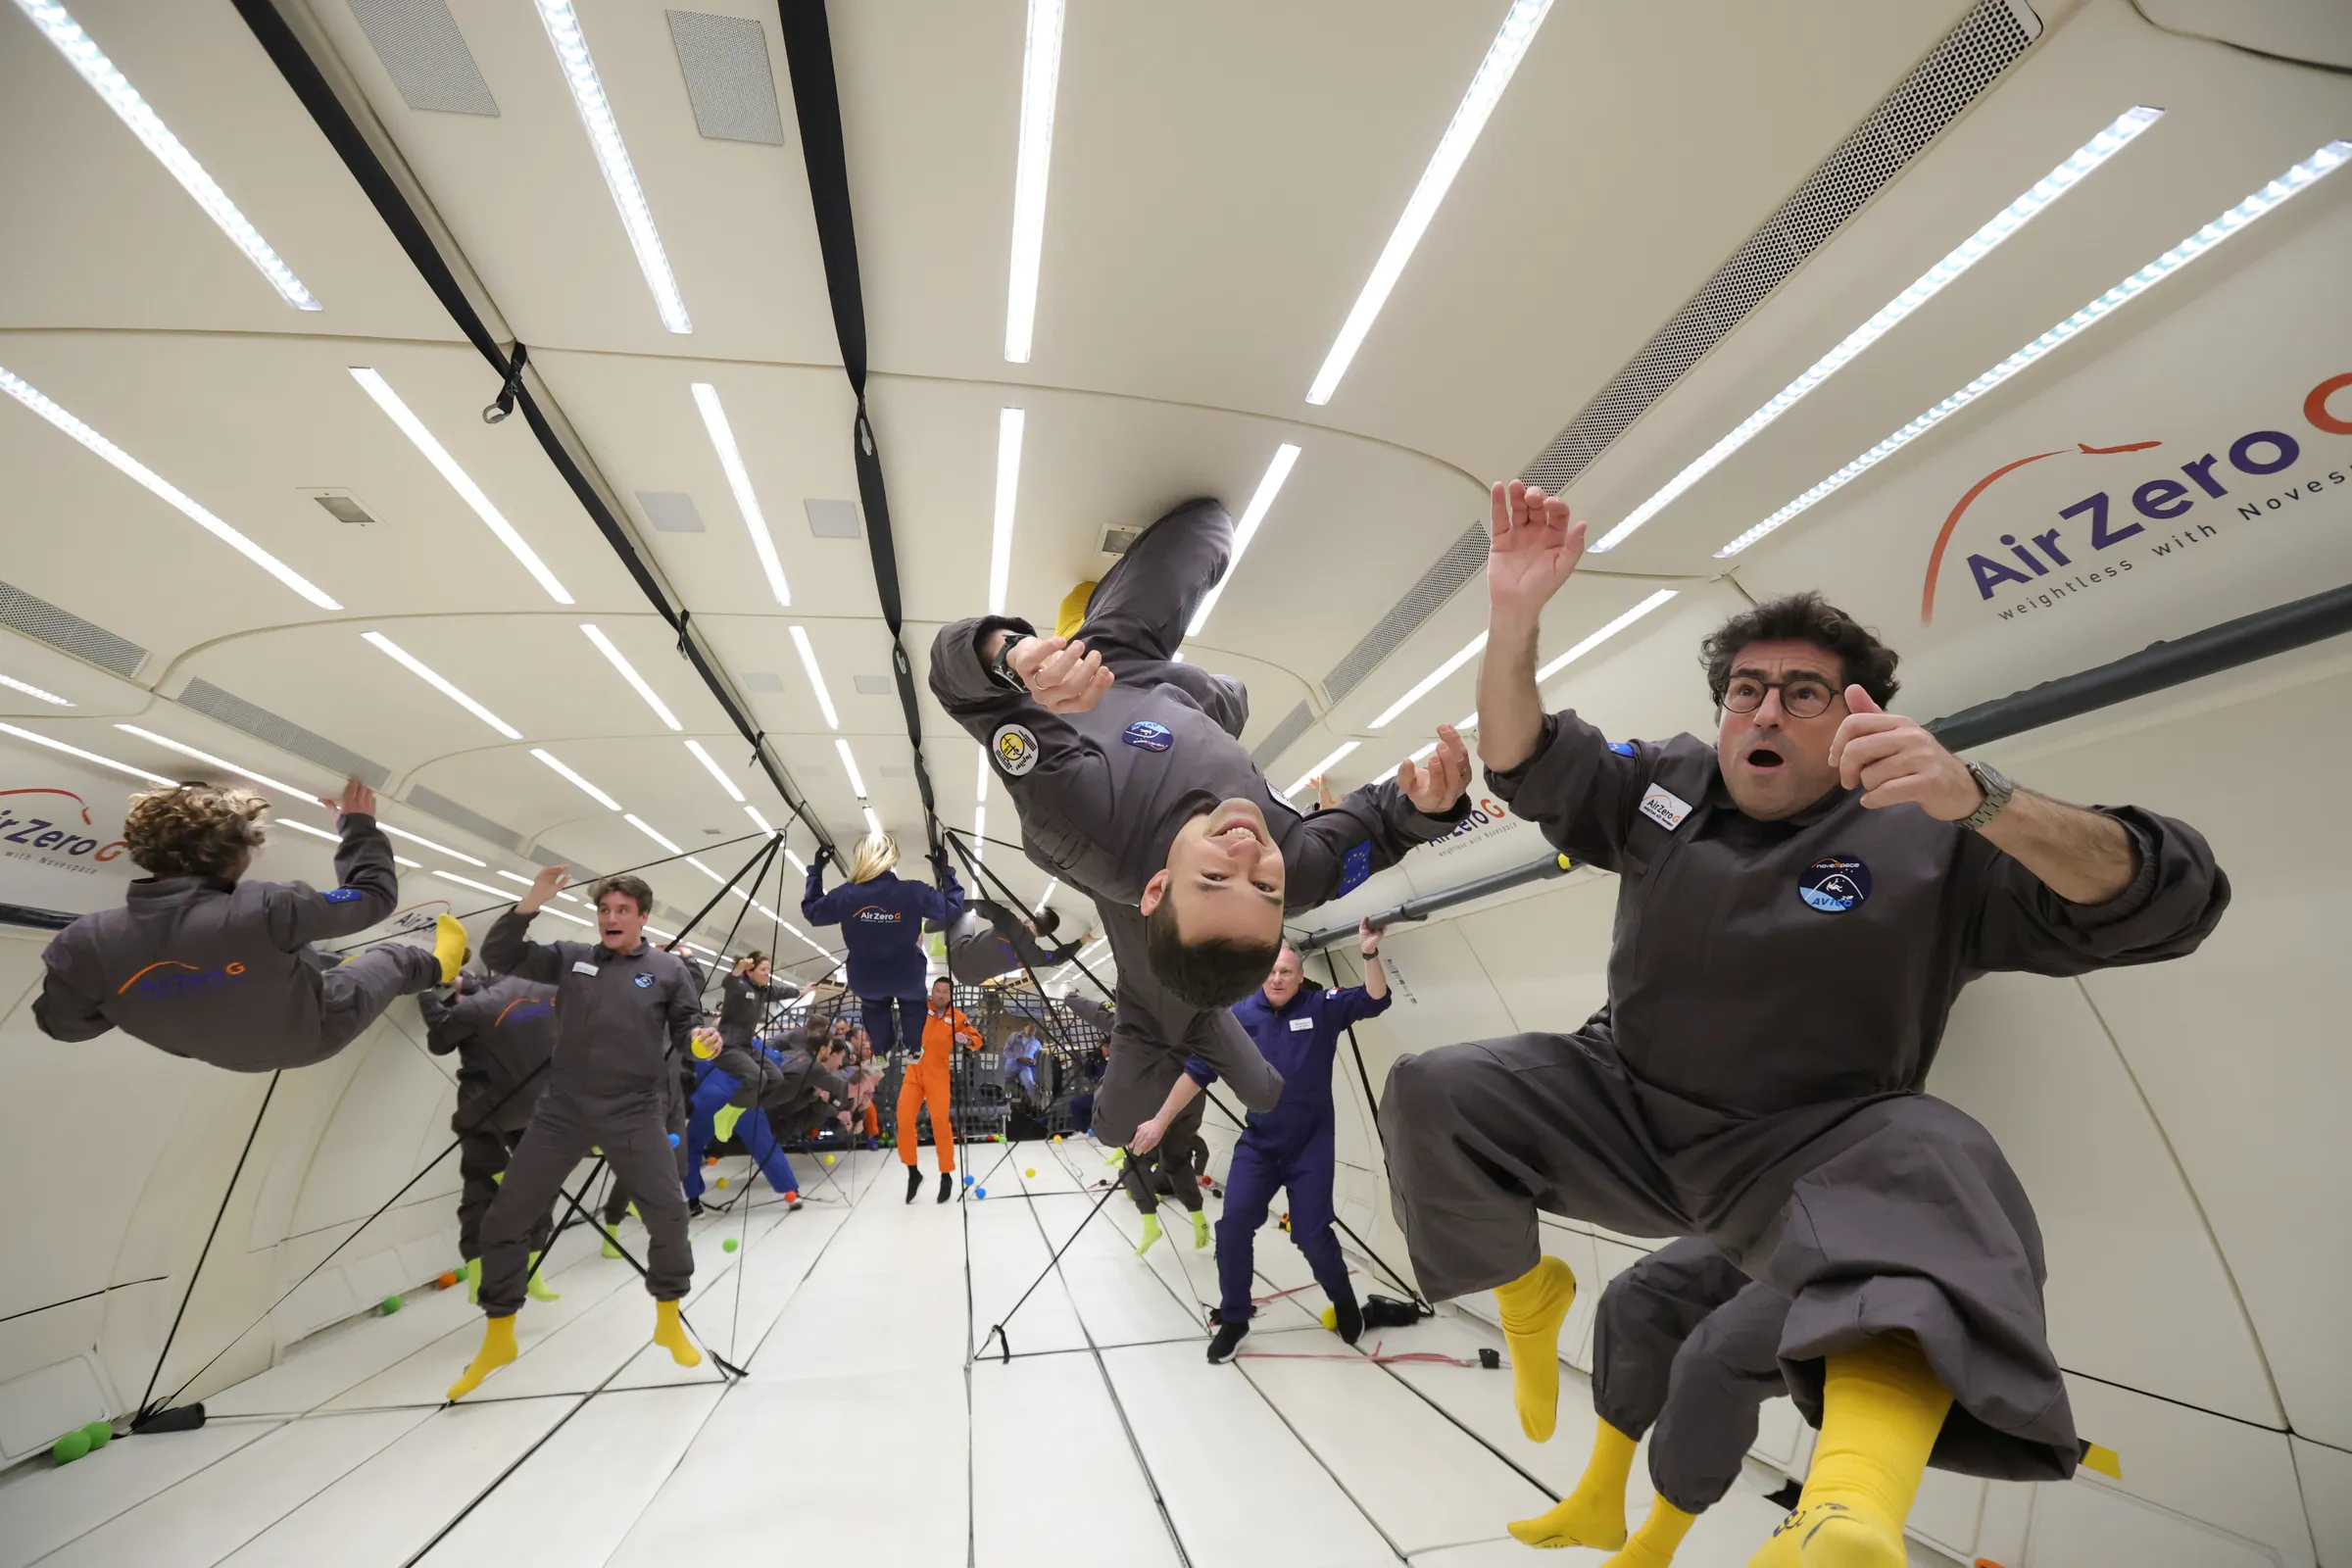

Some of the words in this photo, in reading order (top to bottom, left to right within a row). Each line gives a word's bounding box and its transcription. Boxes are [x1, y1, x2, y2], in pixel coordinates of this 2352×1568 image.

[1998, 559, 2132, 620] weightless
[2152, 523, 2217, 557] with
[2237, 465, 2352, 520] Noves
